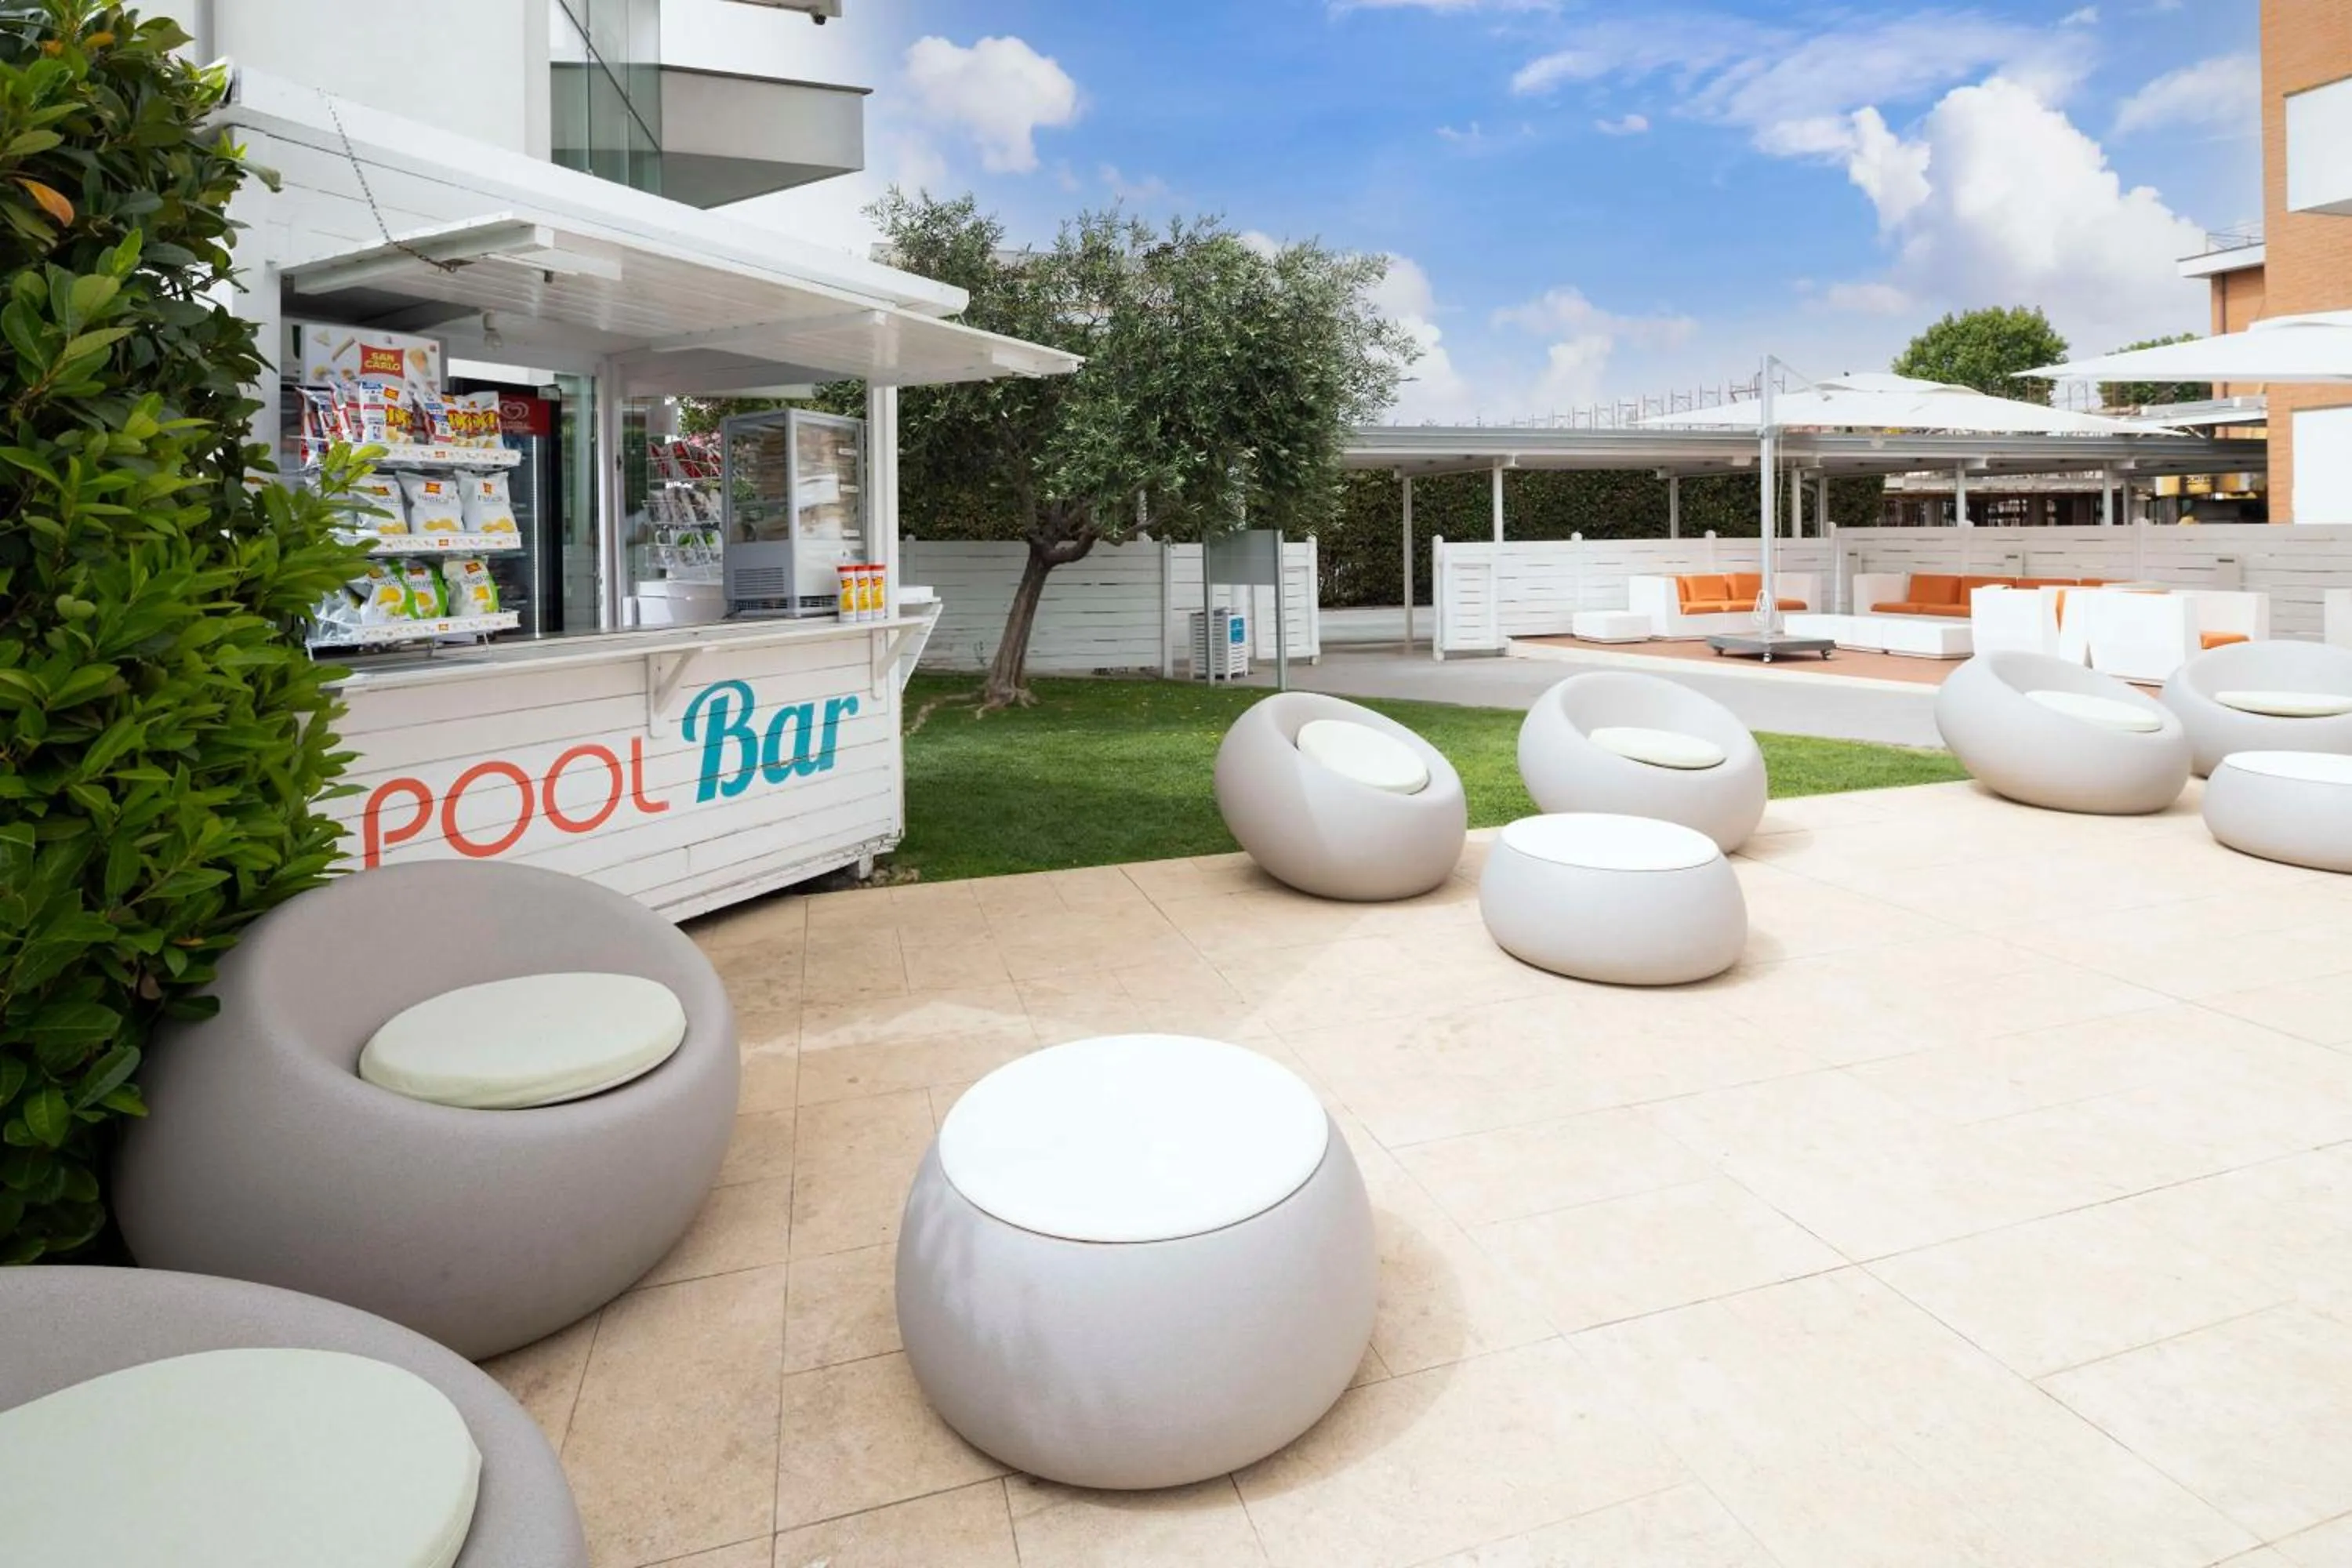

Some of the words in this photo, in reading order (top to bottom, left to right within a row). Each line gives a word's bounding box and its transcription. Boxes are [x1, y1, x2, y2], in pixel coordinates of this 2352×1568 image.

[370, 352, 394, 362] SAN
[364, 360, 401, 371] CARLO
[363, 736, 670, 870] POOL
[682, 679, 860, 804] Bar
